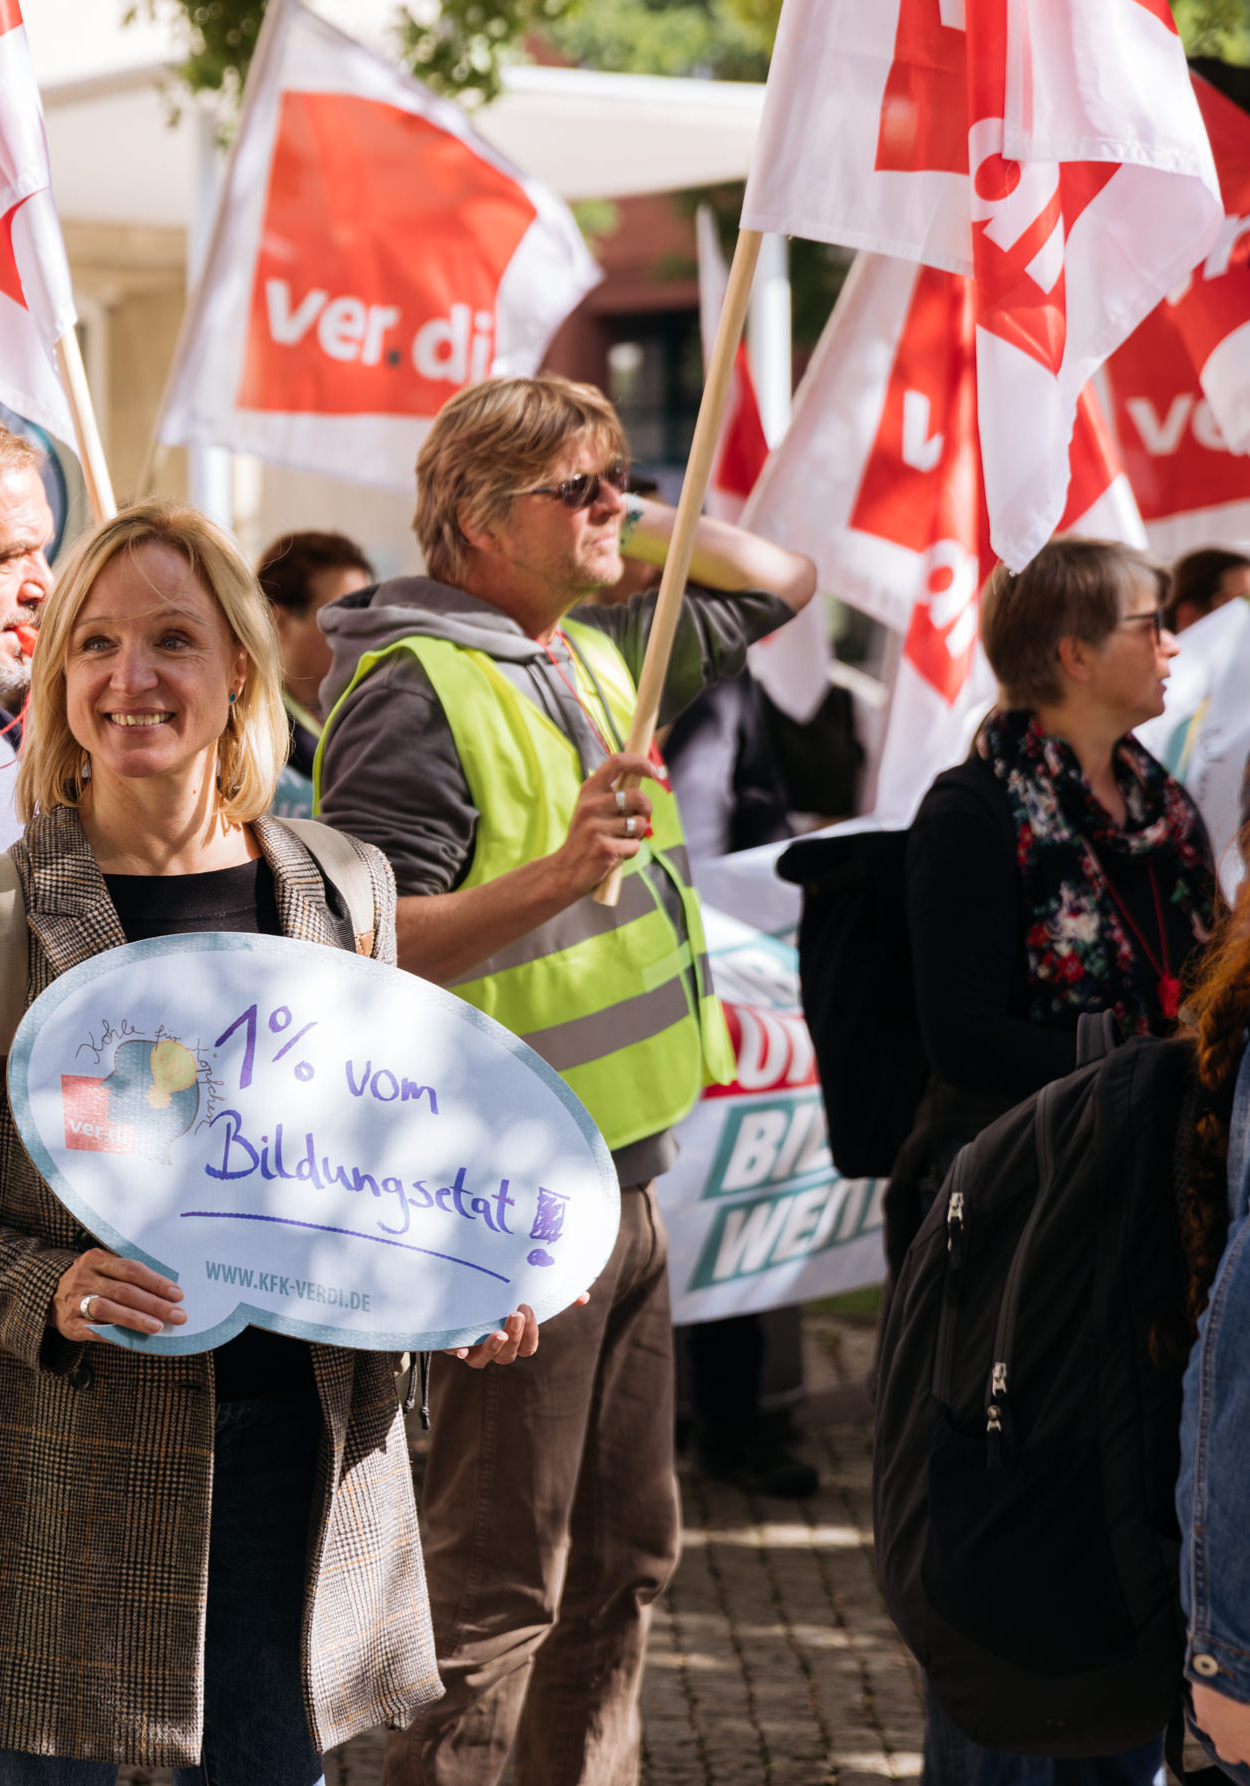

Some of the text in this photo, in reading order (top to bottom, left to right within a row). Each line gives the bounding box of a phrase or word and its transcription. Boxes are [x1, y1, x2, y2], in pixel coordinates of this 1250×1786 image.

[266, 279, 496, 386] ver.di
[214, 1003, 318, 1091] 1%
[69, 1118, 127, 1144] ver.di
[205, 1260, 371, 1313] WWW.KFK-VERDI.DE
